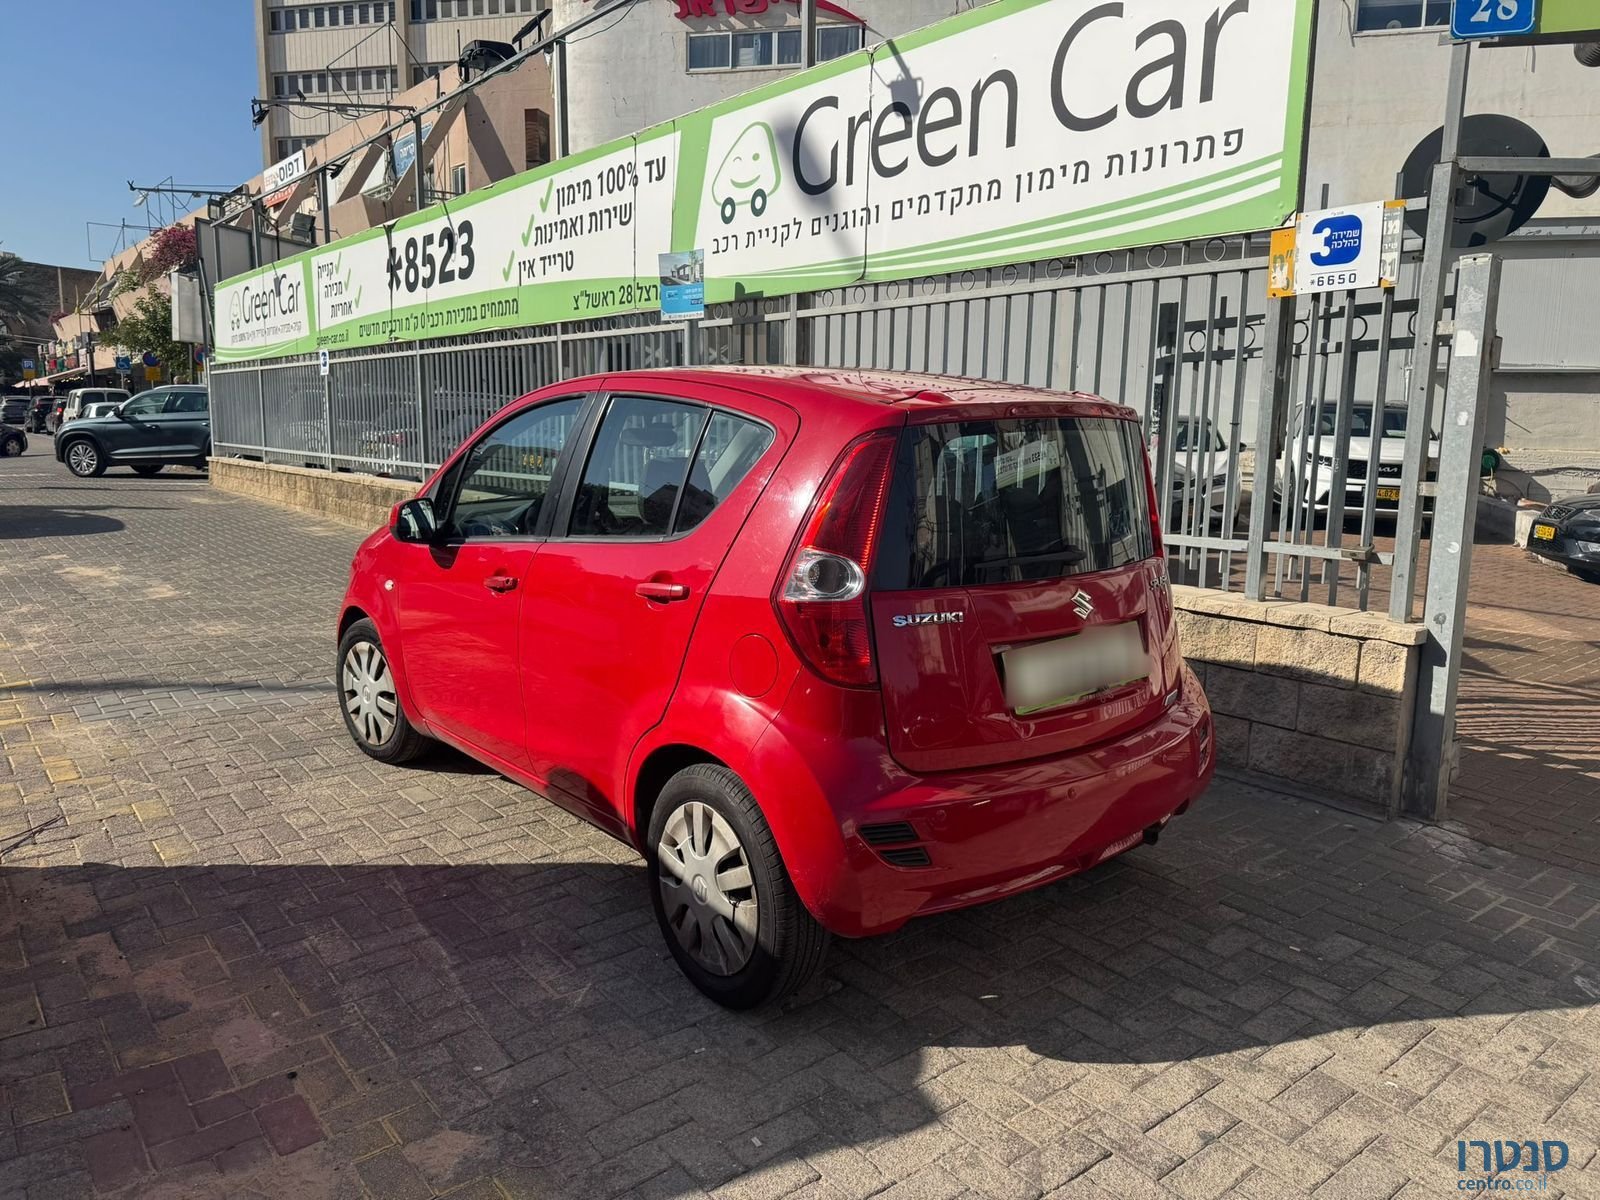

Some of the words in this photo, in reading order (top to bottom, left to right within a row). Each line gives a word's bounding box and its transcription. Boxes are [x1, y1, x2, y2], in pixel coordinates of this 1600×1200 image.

[792, 69, 1019, 196] Green
[1051, 0, 1248, 132] Car
[1104, 128, 1244, 179] פתרונות
[597, 161, 638, 197] 100%
[644, 156, 666, 183] עד
[1015, 160, 1090, 203] מימון
[556, 178, 592, 215] מימון
[891, 178, 1001, 220] מתקדמים
[587, 202, 633, 234] שירות
[811, 204, 880, 236] והוגנים
[534, 214, 584, 247] ואמינות
[745, 217, 802, 249] לקניית
[1331, 229, 1360, 240] שמירה
[712, 234, 738, 254] רכב
[1331, 238, 1360, 249] כהלכה
[317, 262, 334, 280] קנייה
[518, 258, 536, 286] אין
[539, 250, 574, 276] טרייד
[242, 286, 276, 324] Green
[279, 273, 301, 315] Car
[324, 281, 343, 299] מכירה
[573, 288, 616, 311] ראשל"צ
[618, 284, 633, 304] 28
[636, 282, 661, 303] רצל
[331, 300, 353, 319] אחריות
[427, 311, 444, 328] רכבי
[446, 305, 478, 326] במכירת
[480, 298, 519, 320] מתמחים
[359, 321, 381, 338] חדשים
[892, 611, 964, 627] SUZUKI
